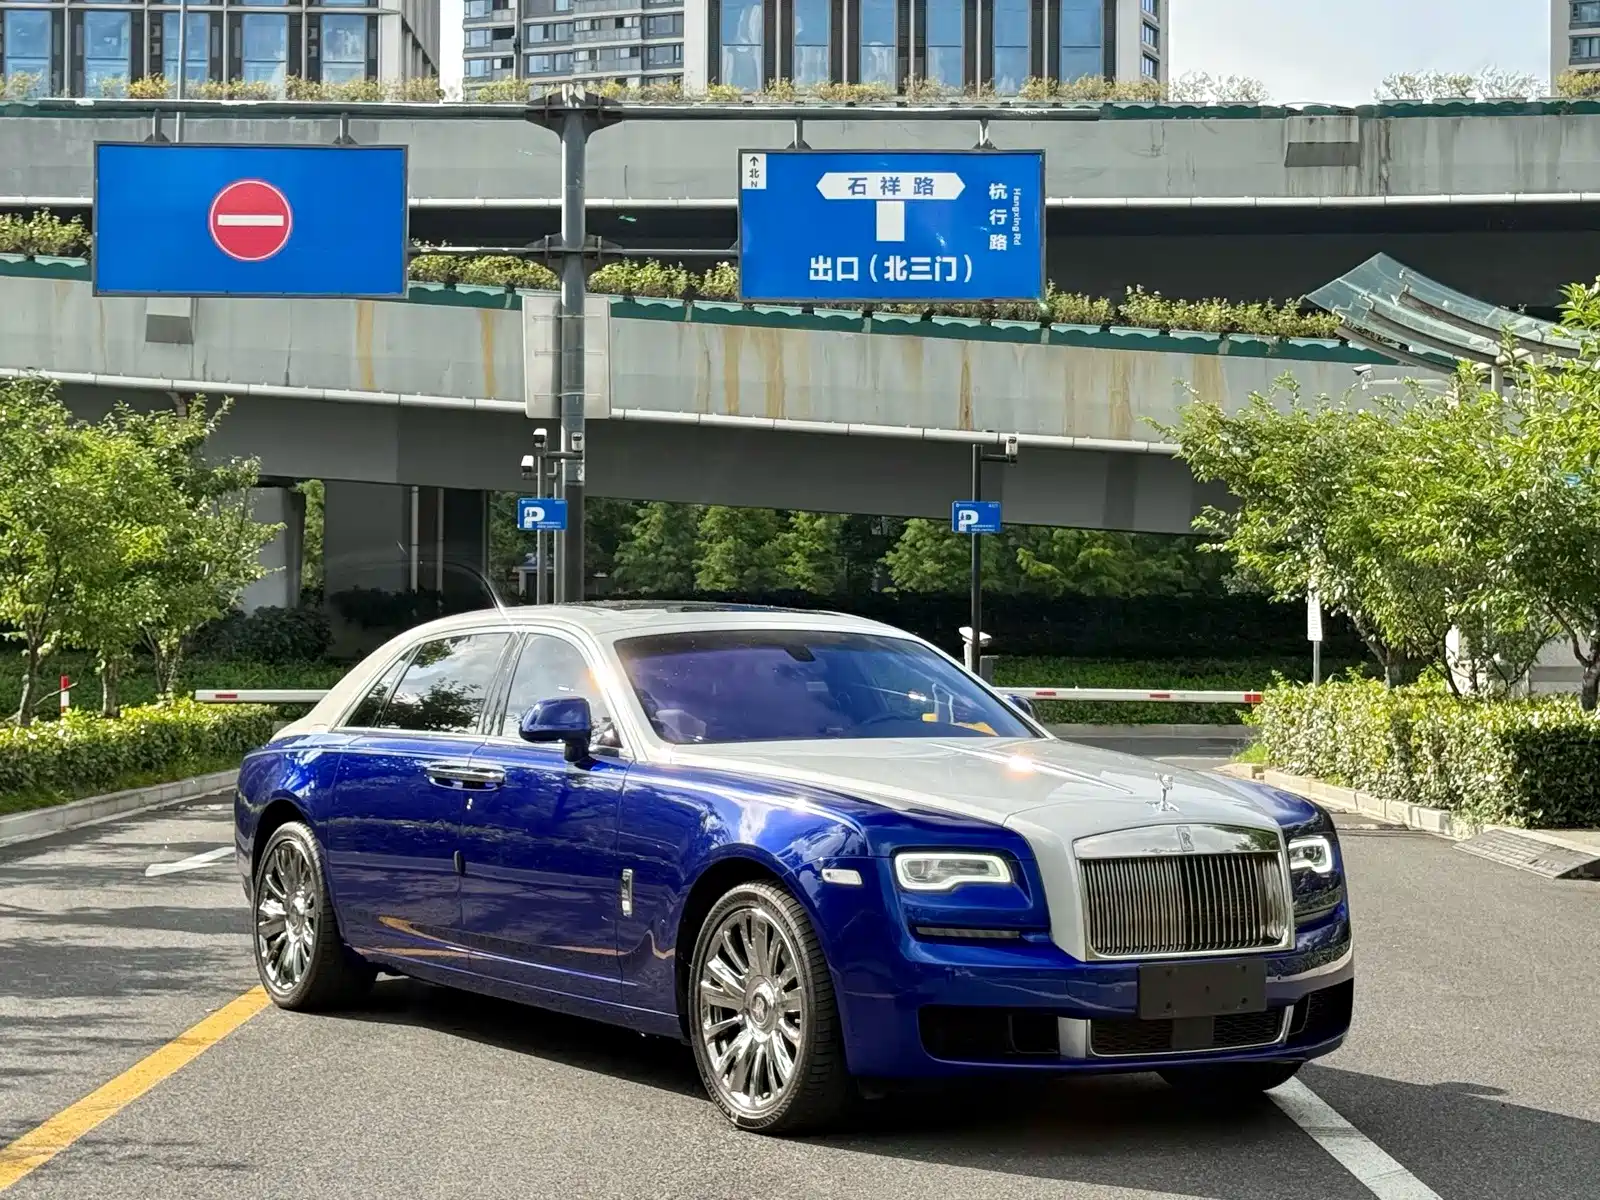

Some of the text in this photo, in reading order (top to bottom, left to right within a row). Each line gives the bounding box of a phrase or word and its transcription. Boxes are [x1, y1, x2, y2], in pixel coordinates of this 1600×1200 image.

[749, 168, 760, 178] 北
[750, 180, 758, 188] N
[847, 176, 935, 196] 石祥路
[988, 182, 1008, 251] 杭行路
[1011, 188, 1022, 246] Hangxing Rd
[809, 254, 973, 283] 出口（北三门）
[523, 506, 545, 528] P
[958, 509, 979, 531] P
